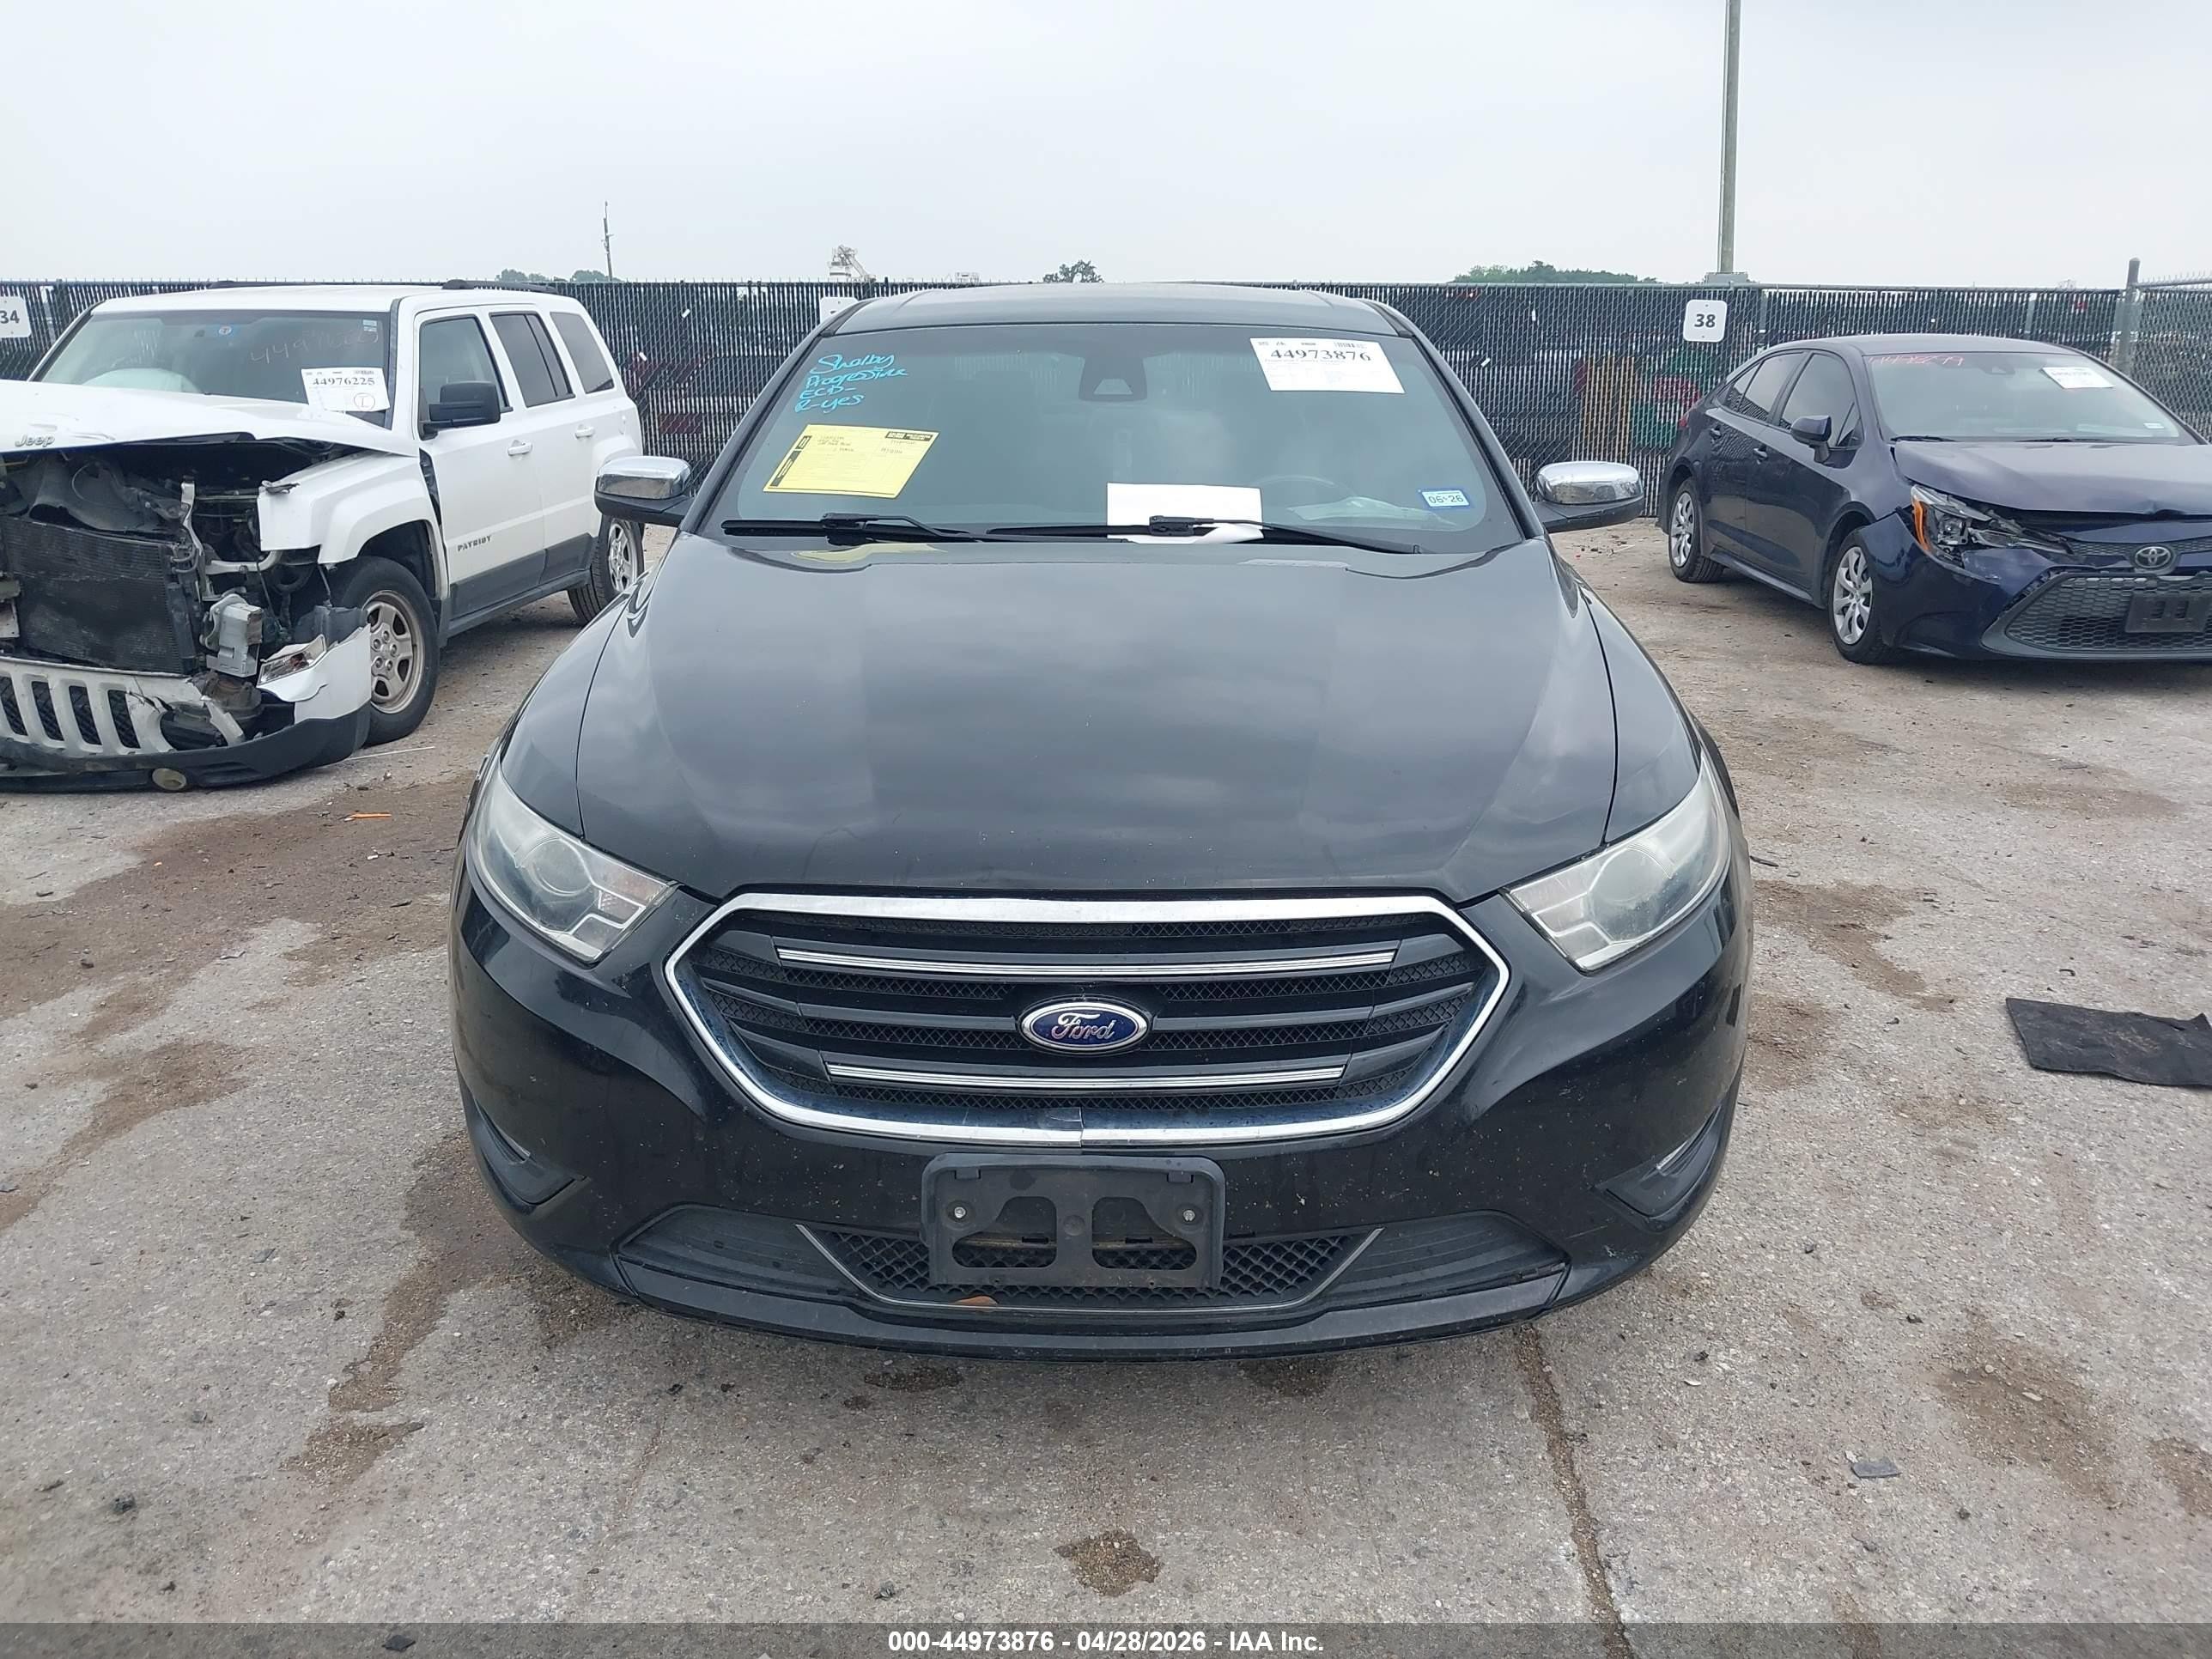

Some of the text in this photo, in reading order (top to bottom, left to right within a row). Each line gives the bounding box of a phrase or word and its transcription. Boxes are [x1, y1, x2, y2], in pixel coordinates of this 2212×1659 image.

[0, 309, 20, 324] 34
[1693, 313, 1716, 328] 38
[1270, 349, 1372, 362] 44973876
[312, 377, 376, 386] 44976225
[15, 434, 56, 447] Jeep
[457, 535, 492, 552] PATRIOT
[1051, 1012, 1117, 1040] Ford
